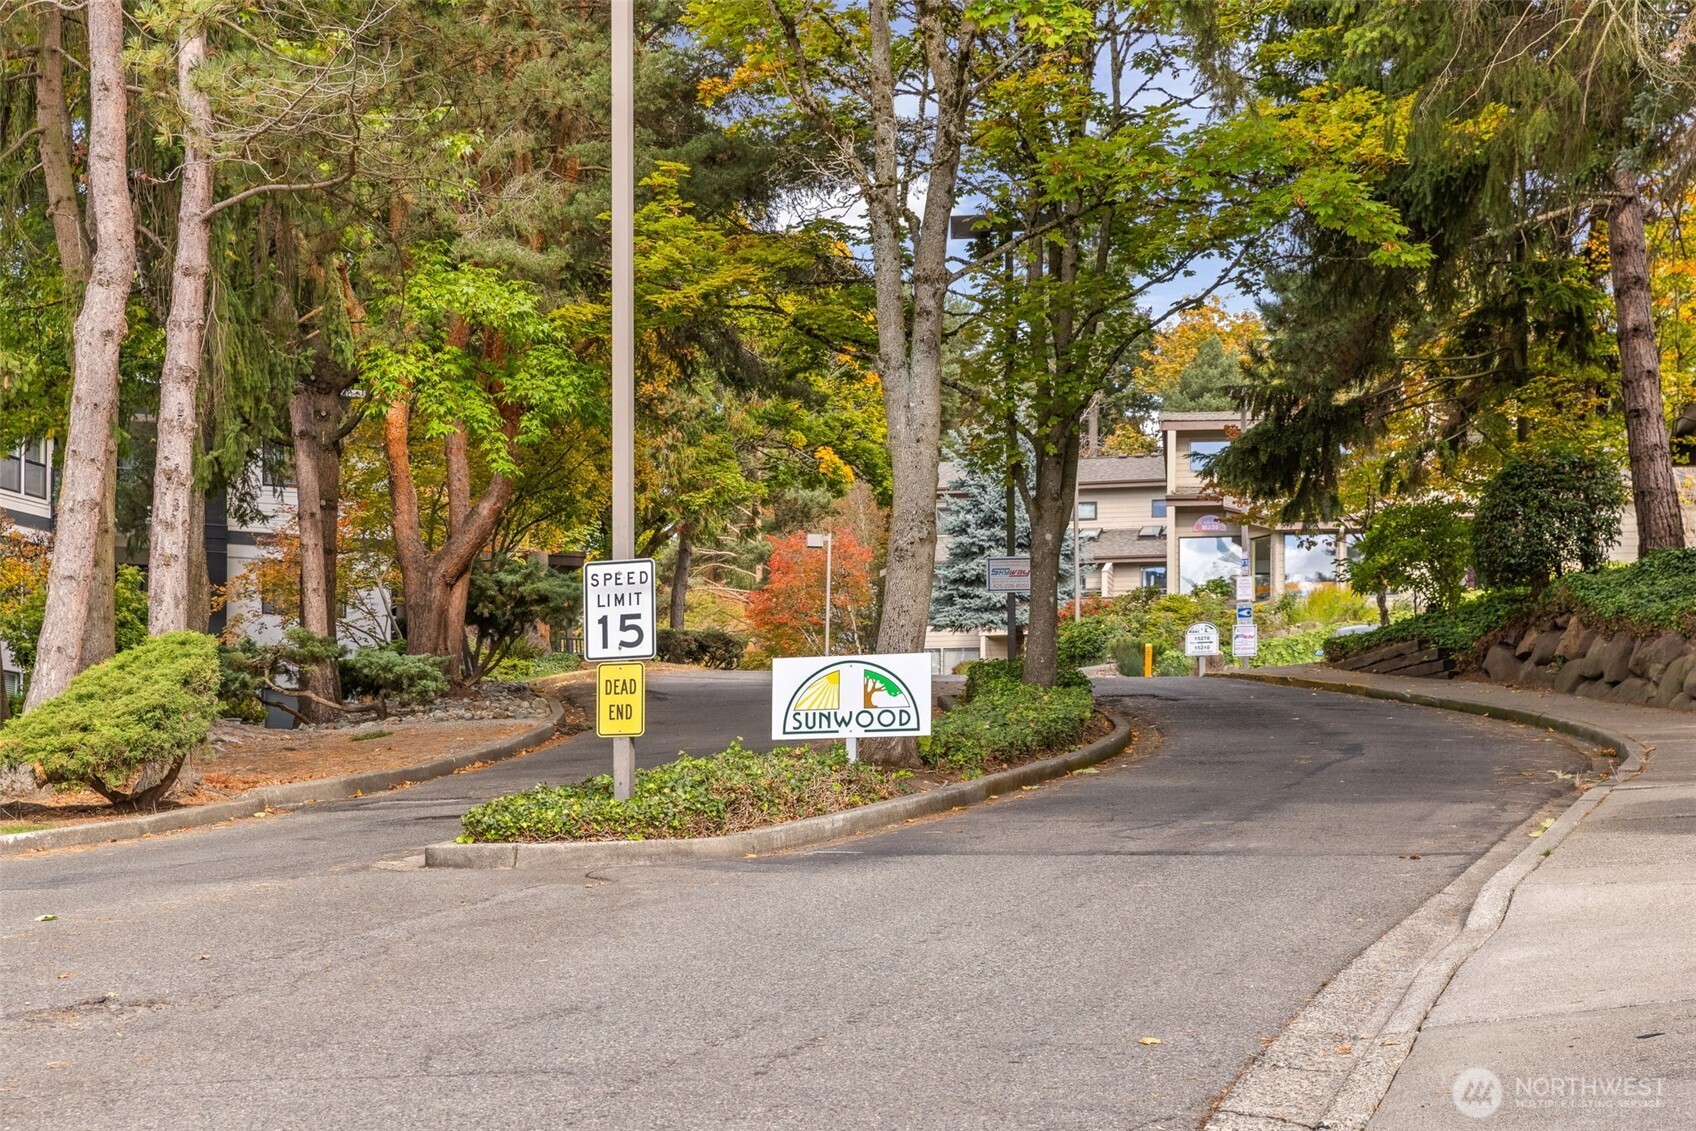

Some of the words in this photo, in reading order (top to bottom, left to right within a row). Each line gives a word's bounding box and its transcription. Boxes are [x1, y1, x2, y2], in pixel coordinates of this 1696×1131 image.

[590, 571, 648, 587] SPEED
[597, 592, 642, 607] LIMIT
[598, 613, 644, 649] 15
[605, 679, 637, 695] DEAD
[609, 704, 633, 720] END
[793, 709, 911, 730] SUNWOOD
